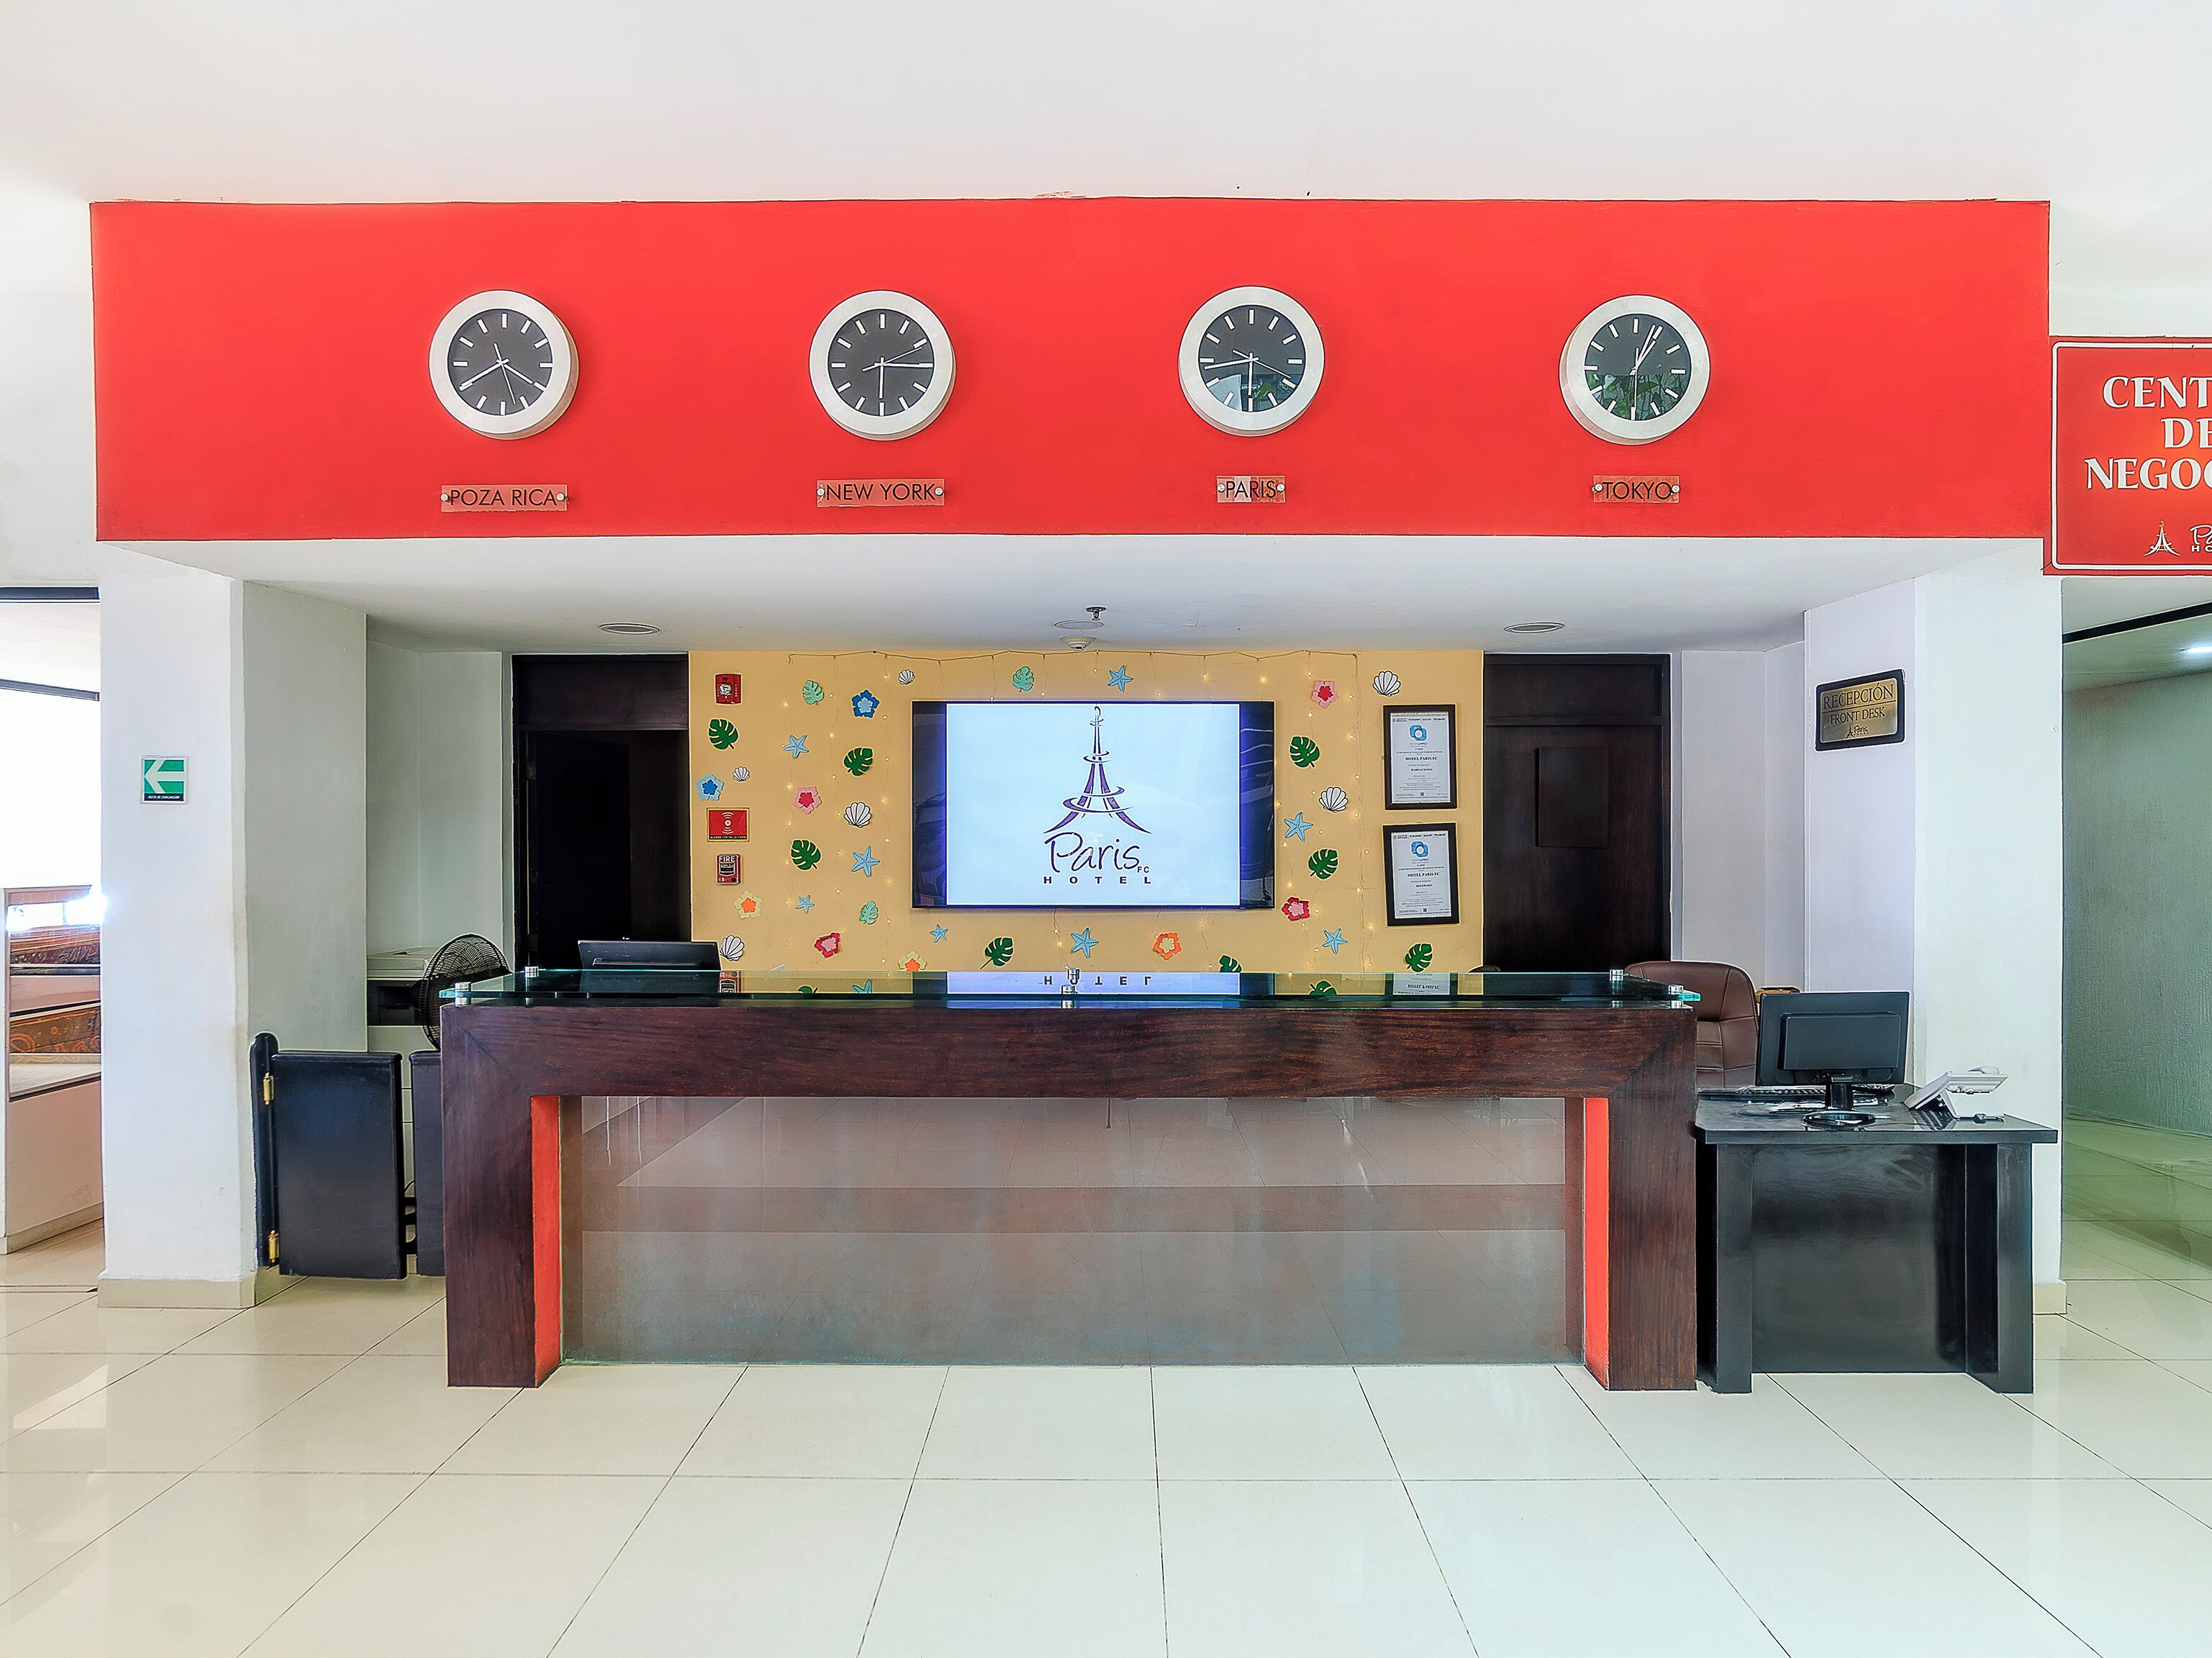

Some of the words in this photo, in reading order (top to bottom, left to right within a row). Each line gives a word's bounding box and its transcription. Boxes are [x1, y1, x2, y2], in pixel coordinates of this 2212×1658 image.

[2161, 417, 2212, 448] DE
[450, 489, 504, 506] POZA
[512, 489, 558, 506] RICA
[827, 484, 874, 500] NEW
[879, 484, 935, 500] YORK
[1226, 480, 1277, 498] PARIS
[1602, 481, 1672, 499] TOKYO
[1823, 682, 1893, 710] RECEPCIÓN
[1831, 710, 1860, 725] FRONT
[1862, 707, 1885, 720] DESK
[1044, 832, 1140, 873] Paris
